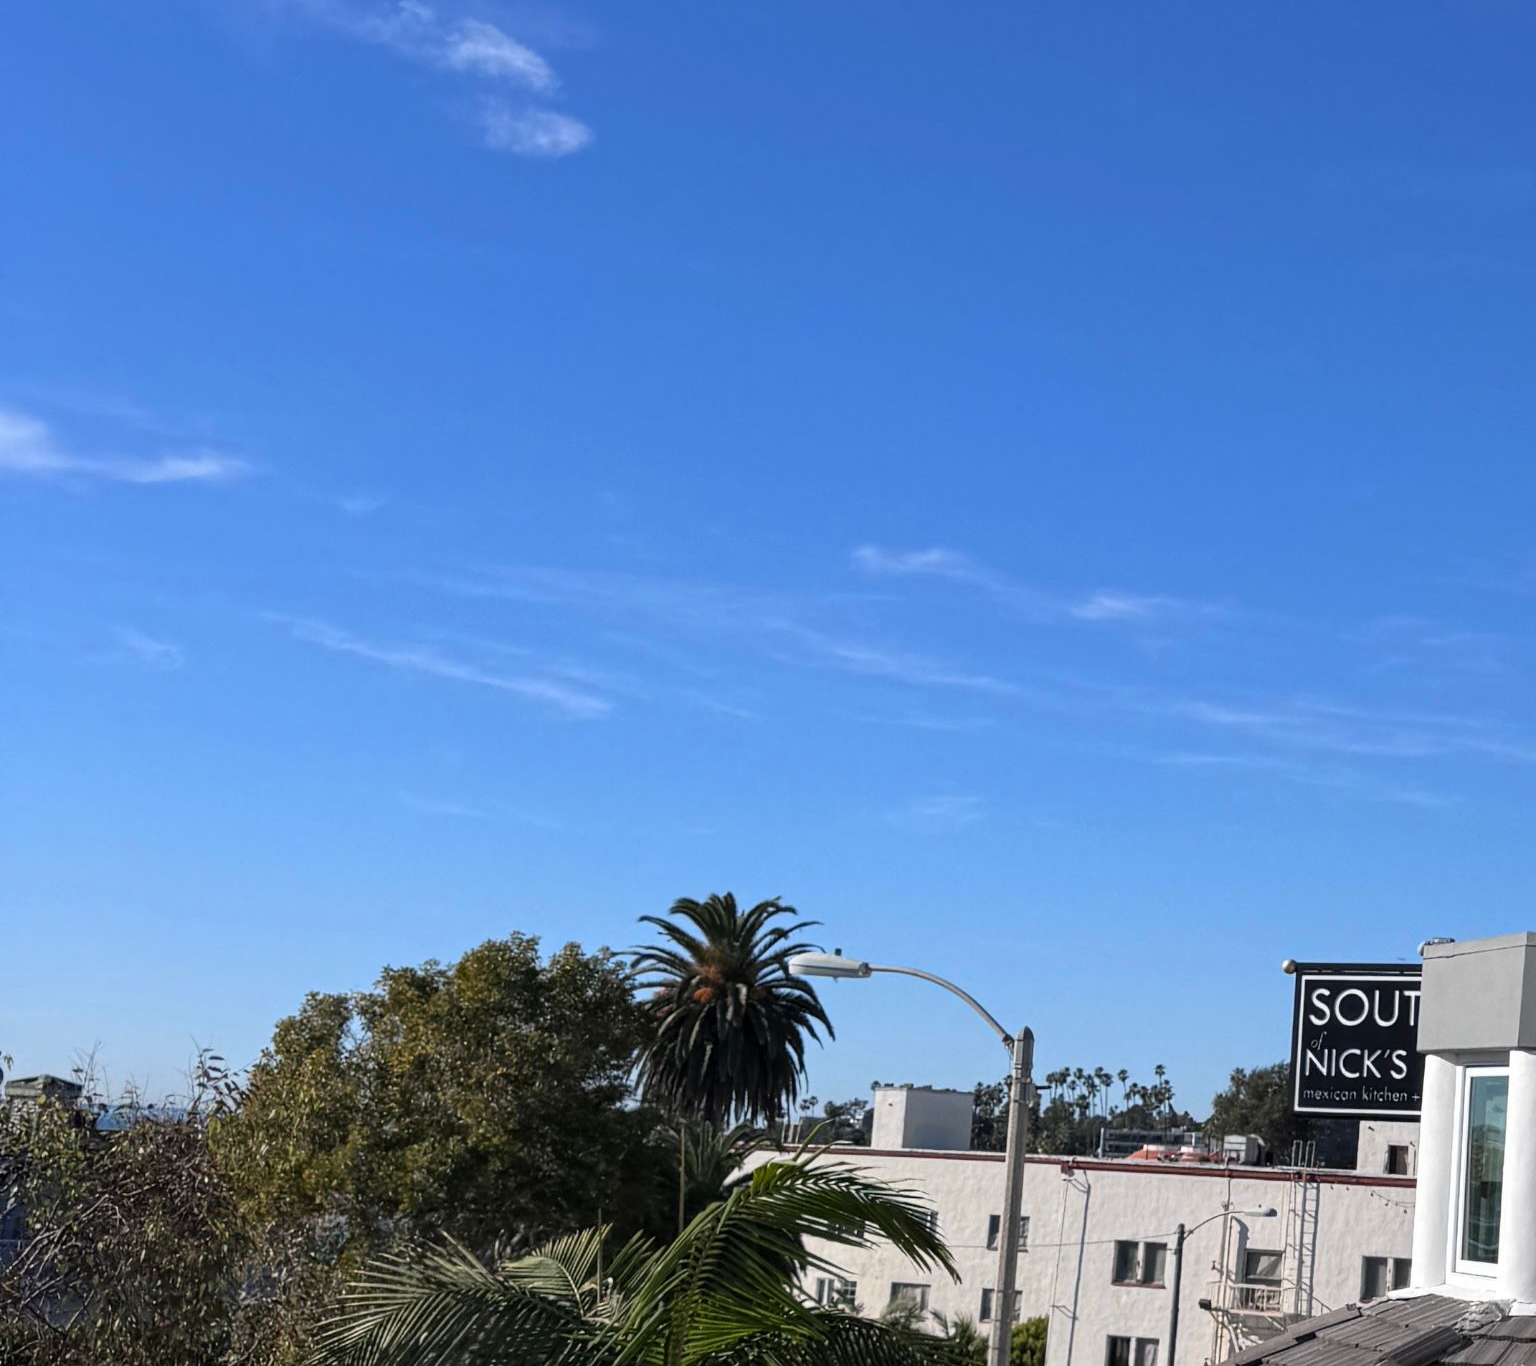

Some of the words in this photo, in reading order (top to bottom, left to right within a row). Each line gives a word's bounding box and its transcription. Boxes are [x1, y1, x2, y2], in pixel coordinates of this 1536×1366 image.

[1310, 1031, 1328, 1050] of
[1304, 1048, 1408, 1080] NICK'S
[1303, 1087, 1357, 1101] mexican
[1361, 1086, 1408, 1102] kitchen
